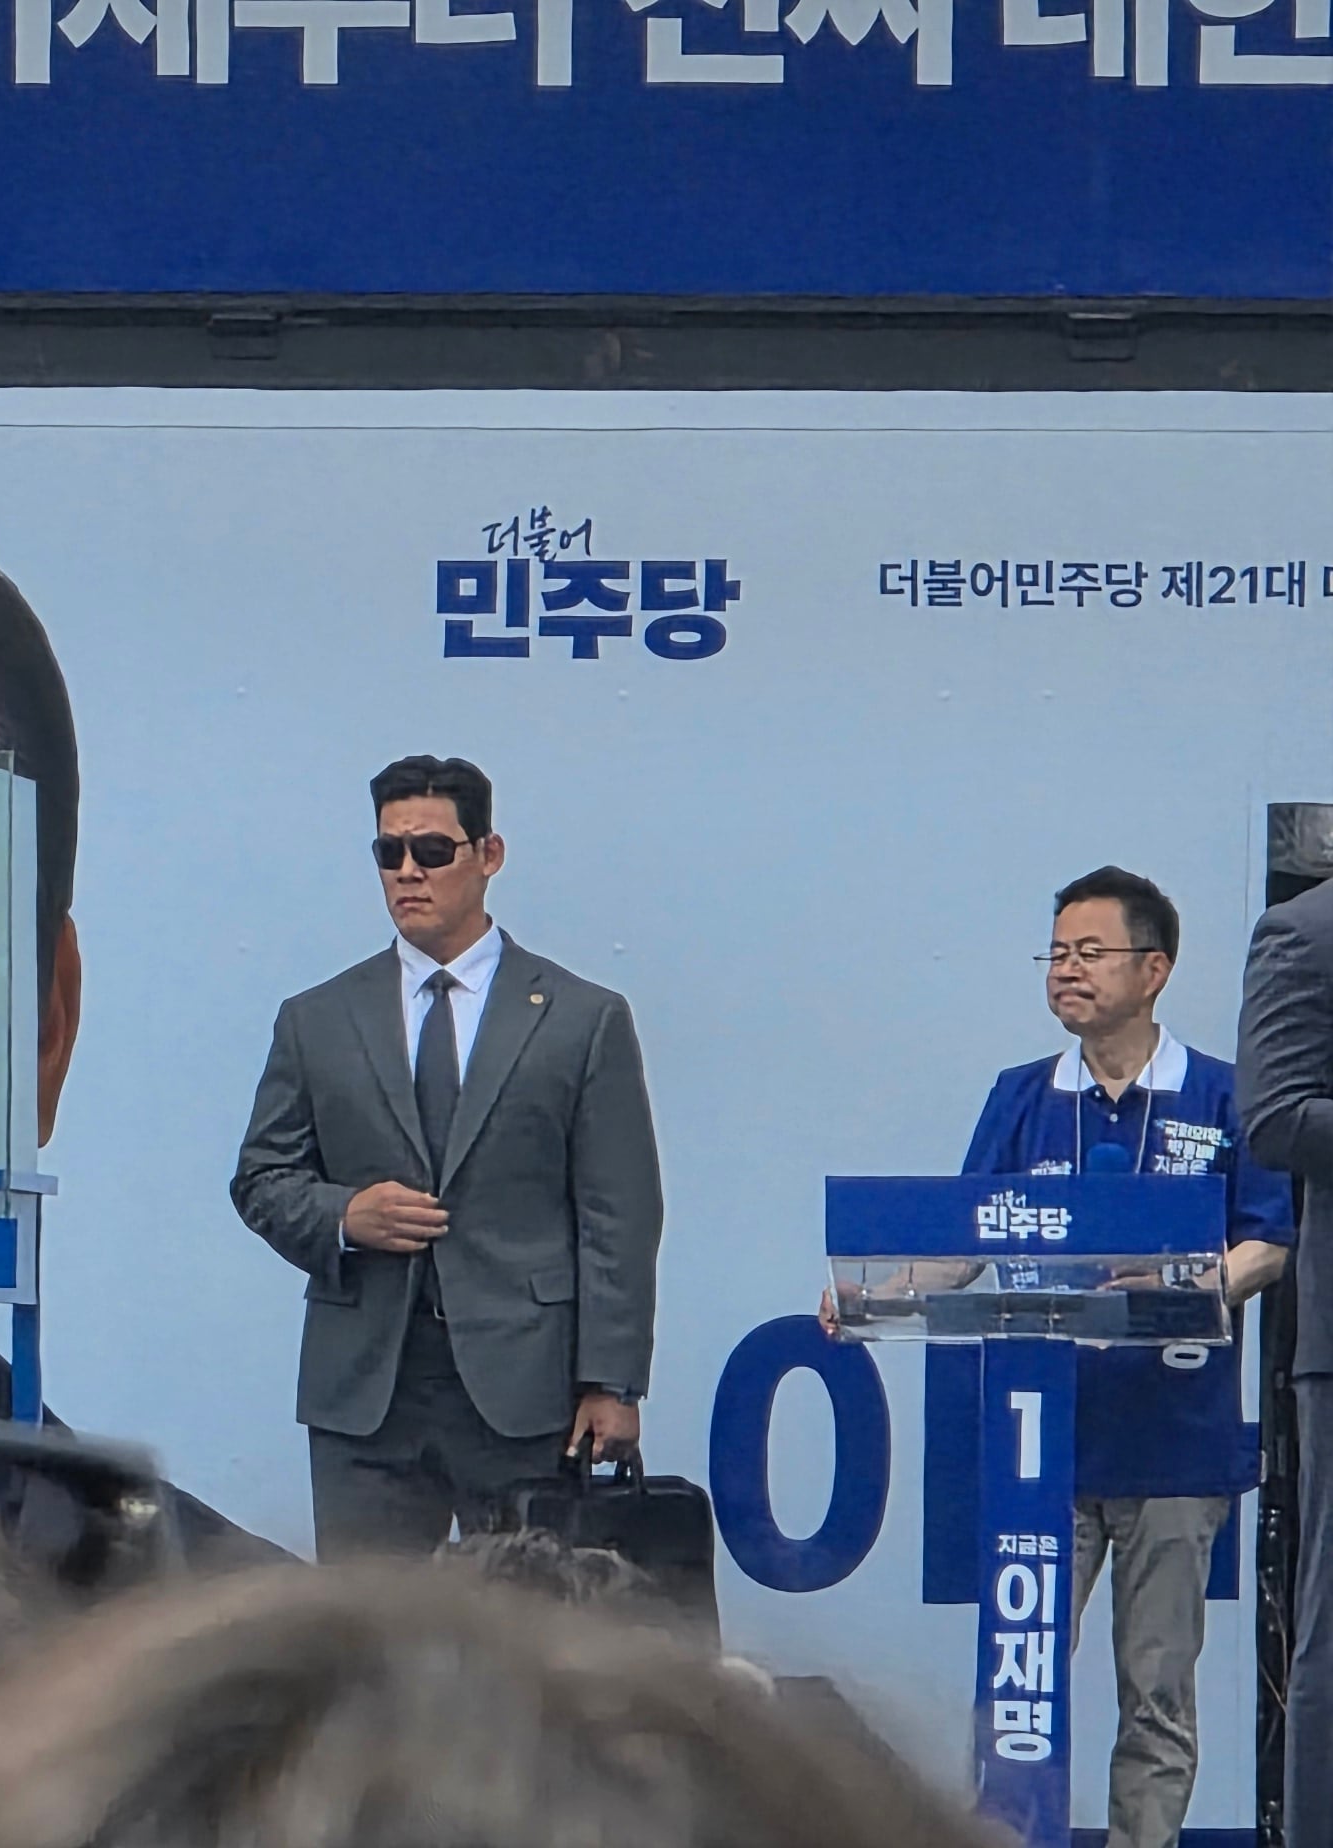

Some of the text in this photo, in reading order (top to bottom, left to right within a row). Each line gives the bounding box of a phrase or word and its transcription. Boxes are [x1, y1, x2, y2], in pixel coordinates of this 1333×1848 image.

[482, 505, 592, 563] 더불어
[436, 558, 741, 661] 민주당
[879, 559, 1149, 608] 더불어민주당
[1161, 560, 1306, 608] 제21대
[977, 1205, 1073, 1240] 민주당
[1010, 1391, 1042, 1479] 1
[998, 1534, 1059, 1557] 지금은
[993, 1563, 1057, 1762] 이재명
